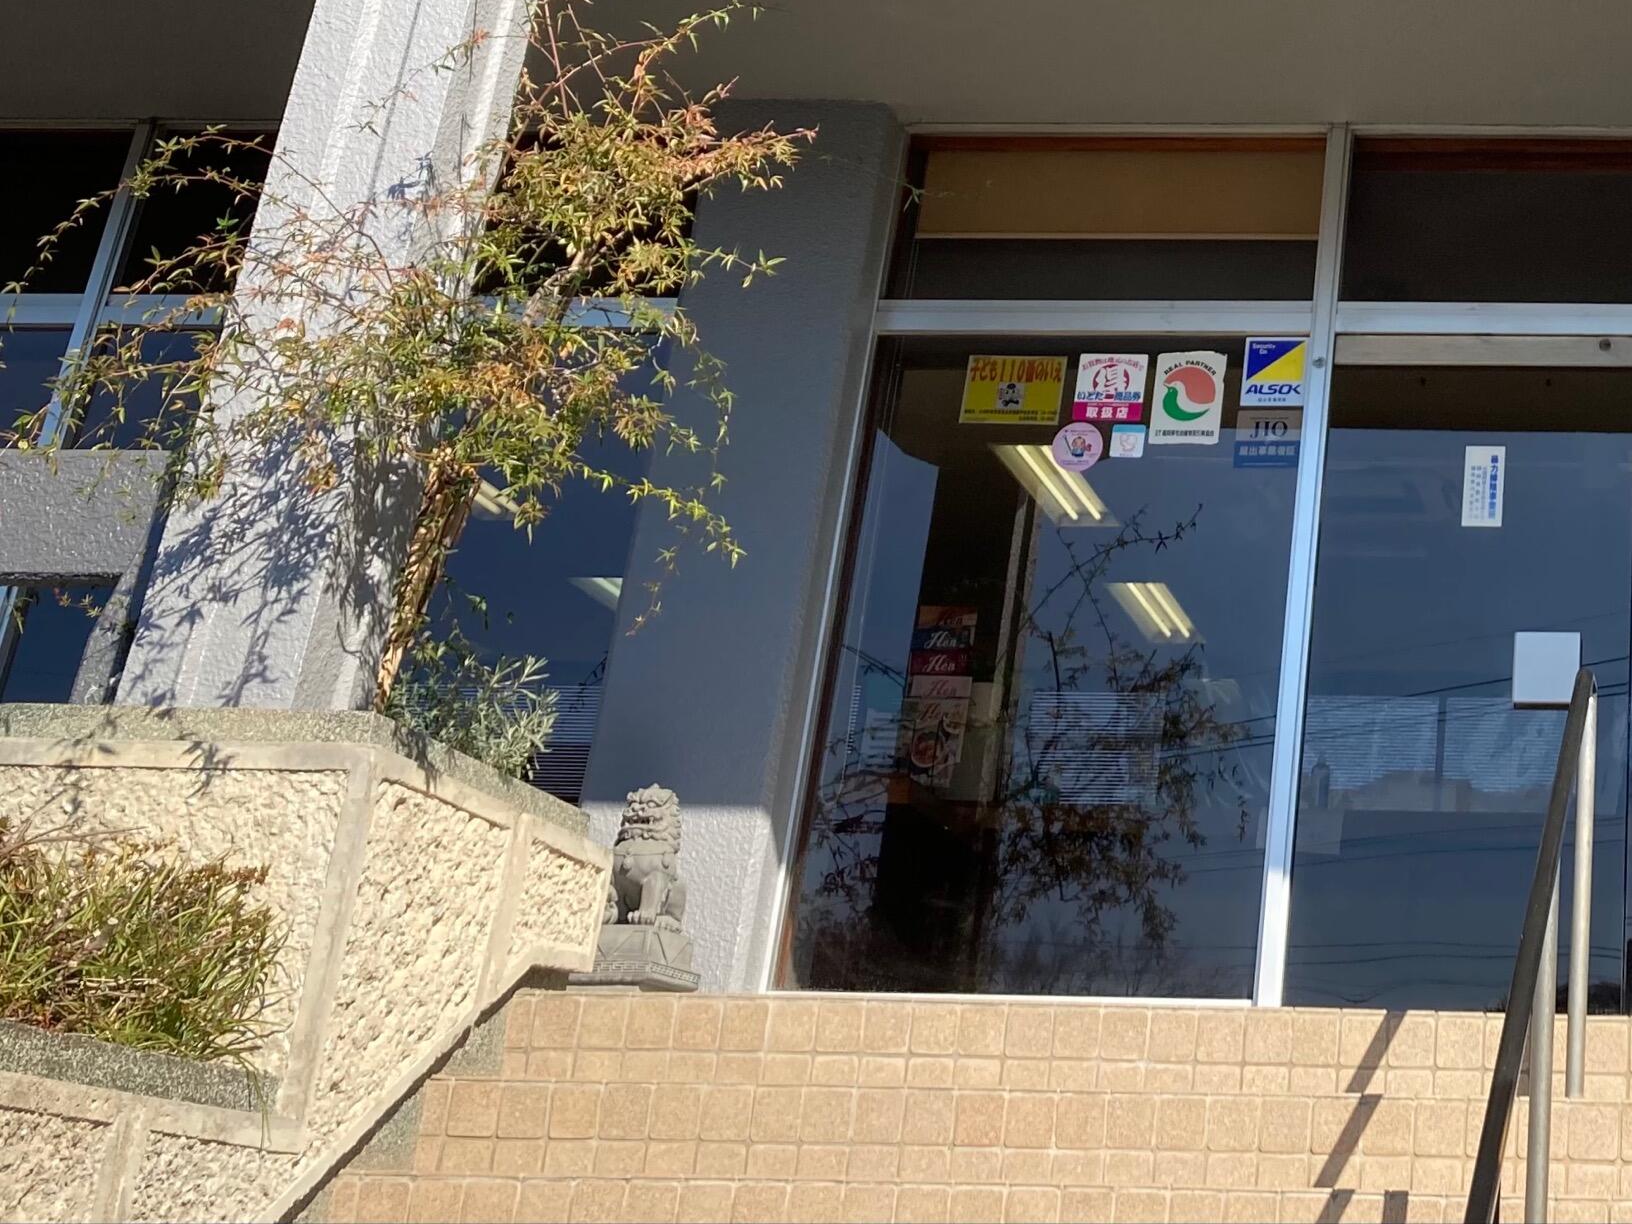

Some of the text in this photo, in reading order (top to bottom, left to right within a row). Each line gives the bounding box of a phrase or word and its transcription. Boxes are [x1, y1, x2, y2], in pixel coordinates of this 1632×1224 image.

[1163, 359, 1217, 376] REAL PARTNER
[1245, 384, 1301, 395] ALSOK
[1085, 406, 1129, 419] 取扱店
[1249, 421, 1288, 439] JIO
